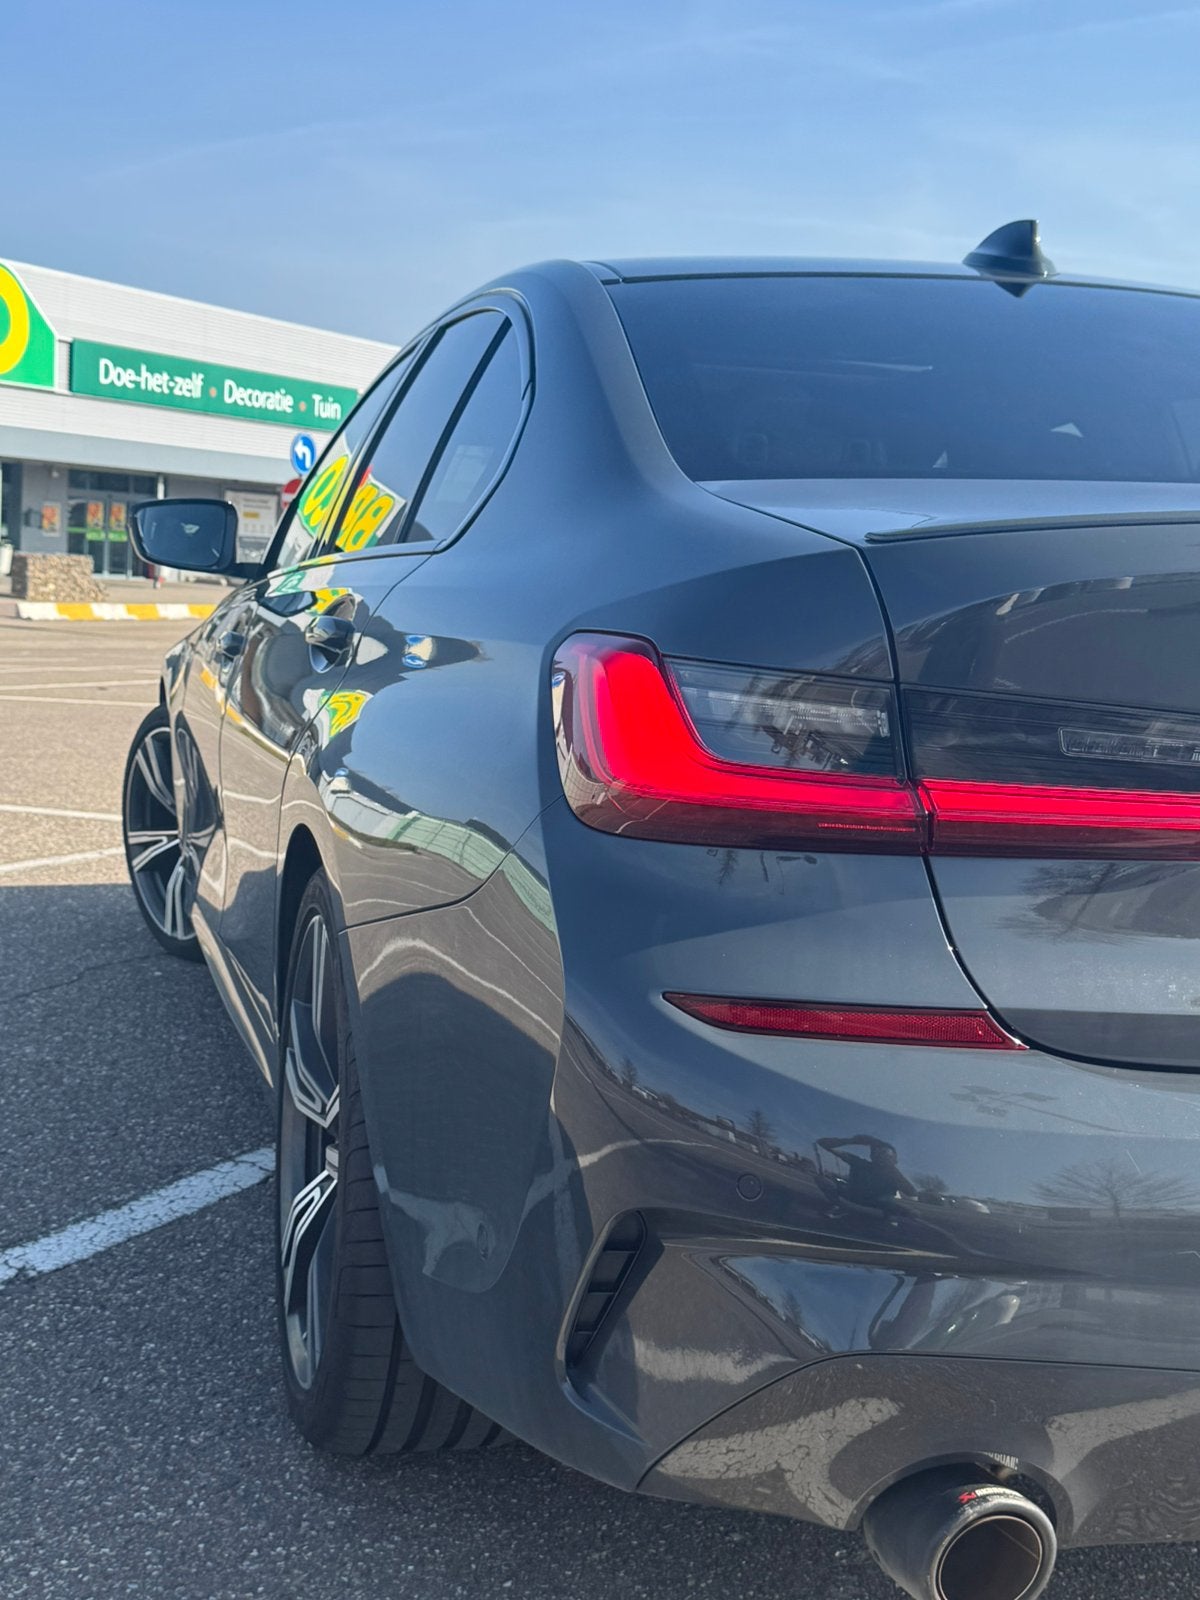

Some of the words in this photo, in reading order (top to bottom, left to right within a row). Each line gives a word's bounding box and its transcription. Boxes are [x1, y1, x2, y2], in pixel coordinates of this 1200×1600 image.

[99, 358, 204, 398] Doe-het-zelf
[224, 379, 294, 413] Decoratie
[312, 394, 342, 420] Tuin
